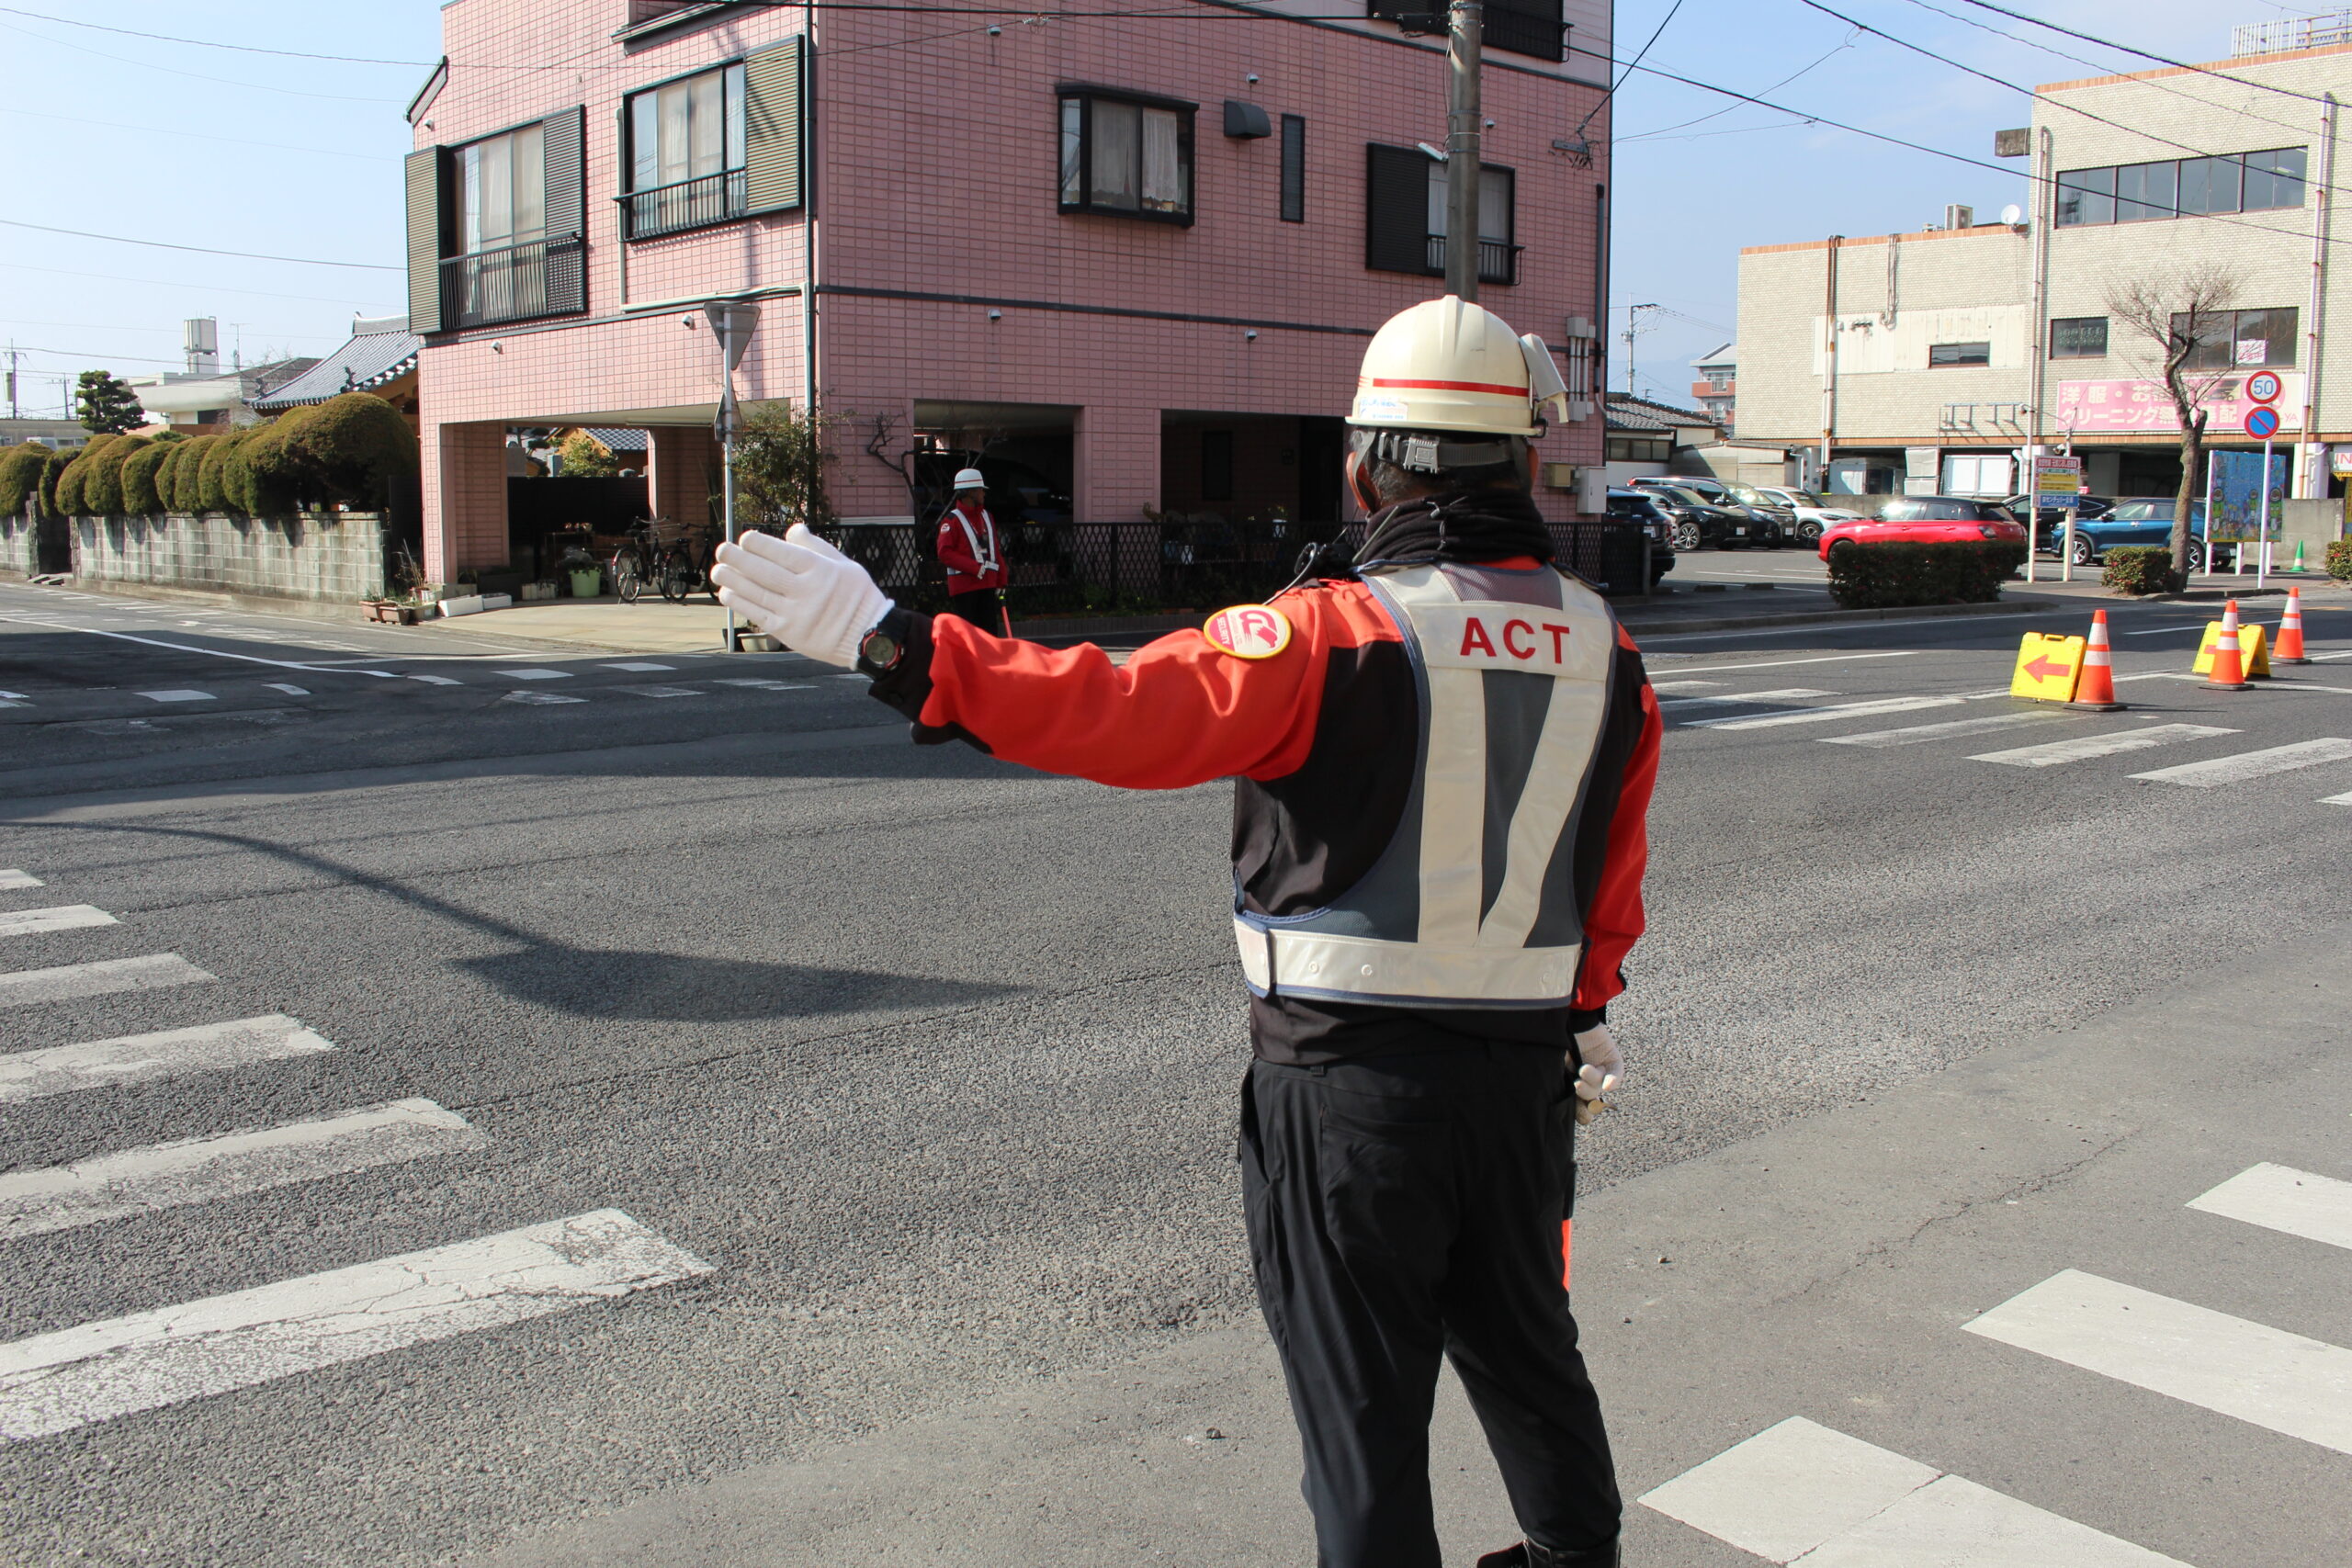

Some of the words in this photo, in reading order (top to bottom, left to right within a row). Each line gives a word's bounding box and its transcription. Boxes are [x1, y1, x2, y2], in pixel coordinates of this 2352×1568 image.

[2254, 379, 2274, 395] 50
[2061, 403, 2237, 425] クリーニング無集配
[1460, 617, 1570, 664] ACT
